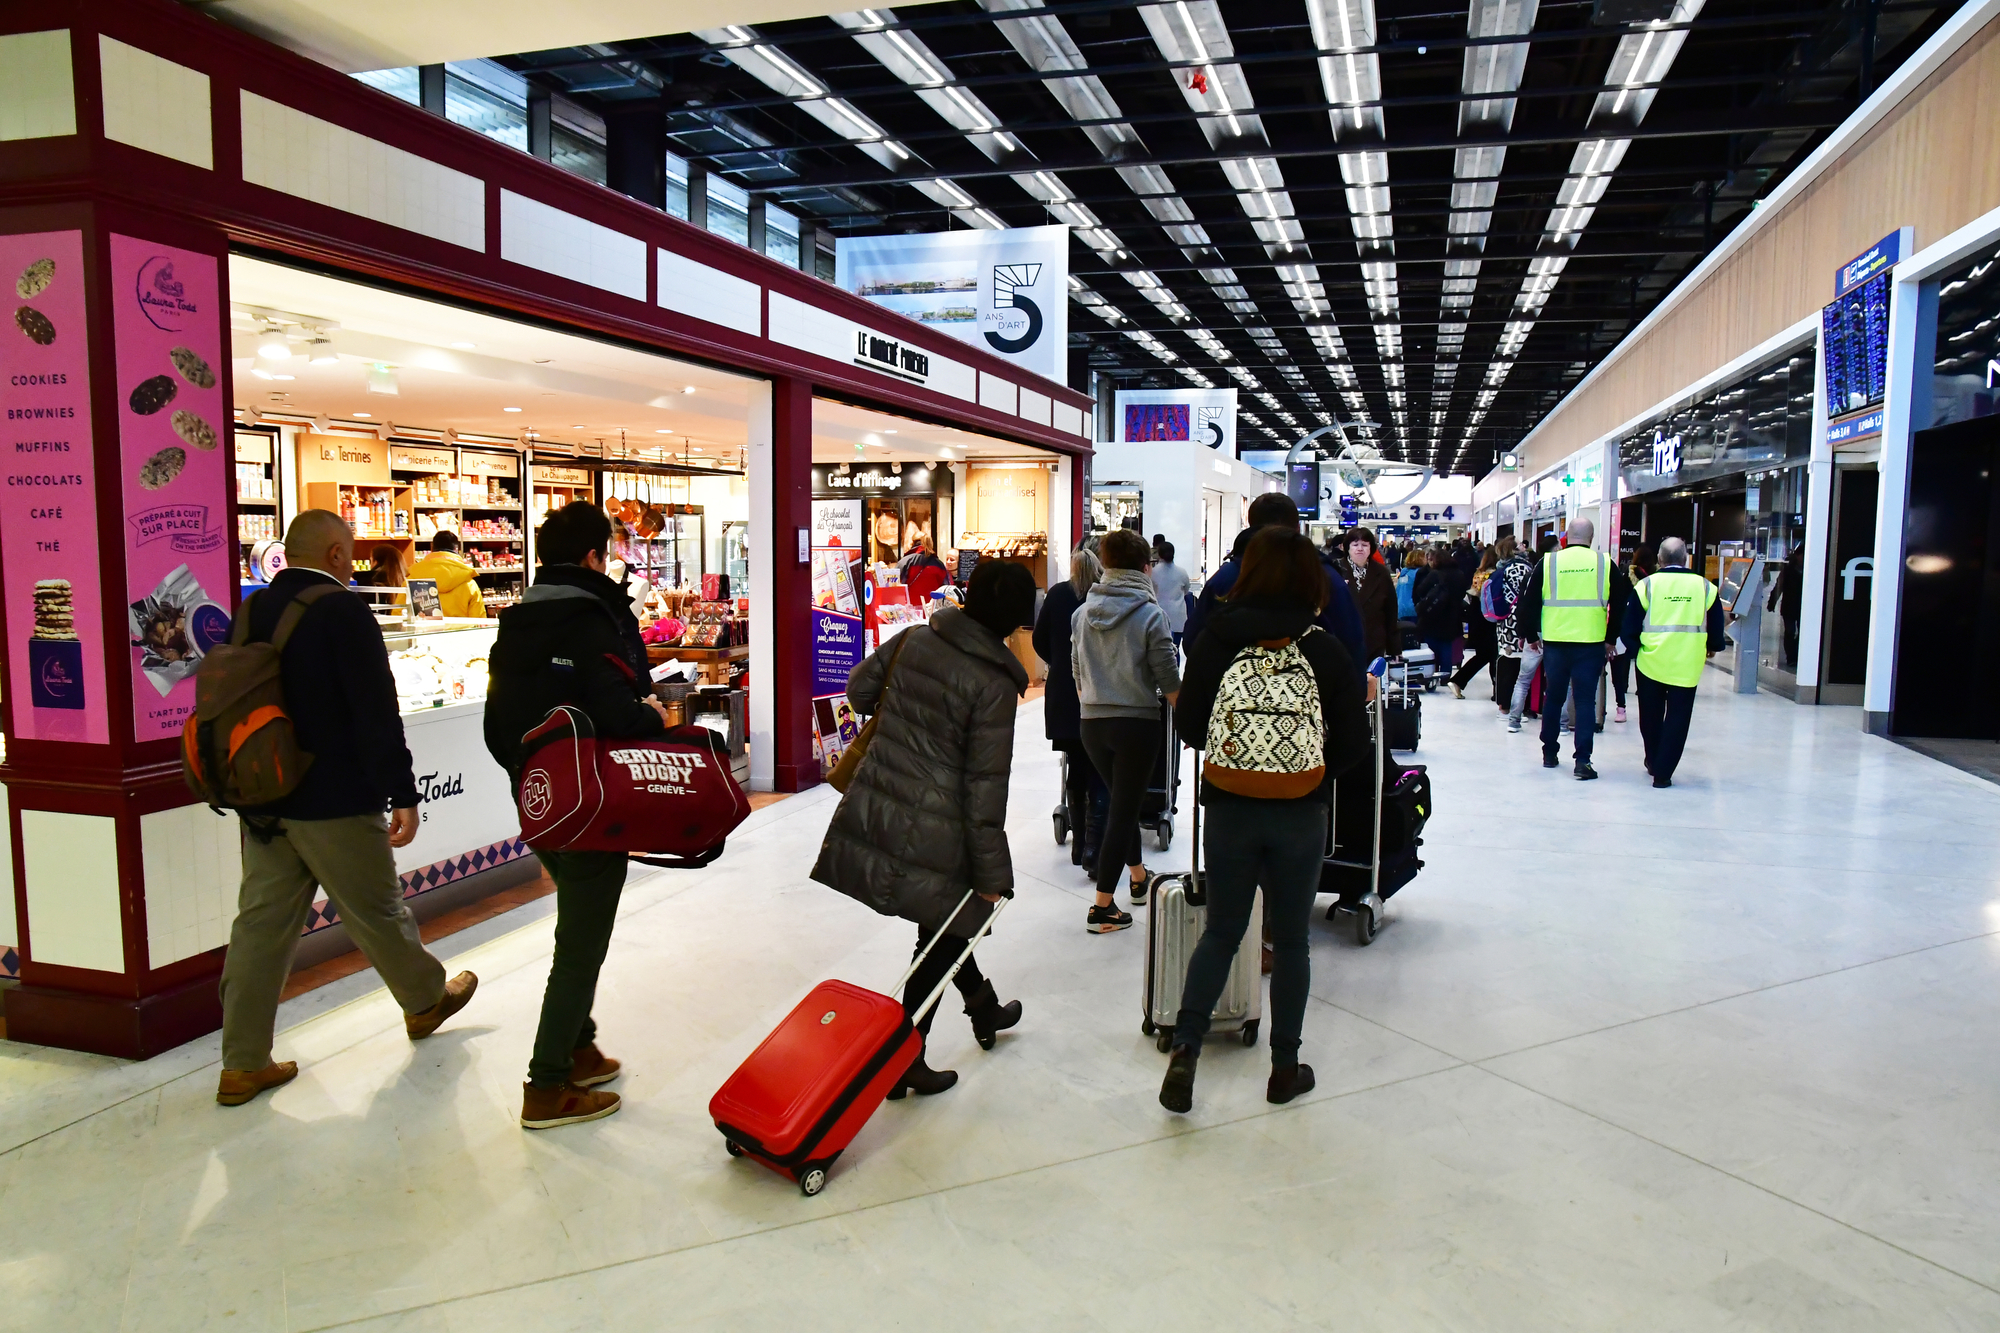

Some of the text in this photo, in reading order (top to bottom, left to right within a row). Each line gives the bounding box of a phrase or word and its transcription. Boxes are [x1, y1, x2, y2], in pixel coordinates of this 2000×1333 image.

[175, 298, 197, 313] Todd
[984, 312, 1004, 322] ANS
[998, 320, 1026, 330] D'ART
[858, 331, 867, 356] LE
[11, 374, 67, 386] COOKIES
[8, 407, 75, 419] BROWNIES
[15, 441, 70, 453] MUFFINS
[320, 444, 372, 464] Les Terrines
[1653, 430, 1682, 477] fnac
[433, 456, 449, 467] Fine
[8, 475, 83, 486] CHOCOLATS
[541, 470, 548, 479] Le
[1003, 474, 1012, 487] et
[827, 472, 902, 491] Cave d'Affinage
[31, 506, 63, 519] CAFÉ
[139, 509, 175, 526] PRÉPARÉ
[183, 510, 201, 518] CUIT
[829, 507, 851, 519] chocolat
[1358, 505, 1455, 521] HALLS 3 ET 4
[142, 520, 200, 537] SUR PLACE
[1621, 528, 1640, 537] fnac
[36, 540, 60, 552] THÉ
[149, 708, 173, 718] L'ART
[176, 706, 189, 715] DU
[608, 749, 707, 768] SERVETTE
[628, 763, 693, 784] RUGBY
[418, 770, 464, 804] Todd
[647, 783, 686, 795] GENÈVE
